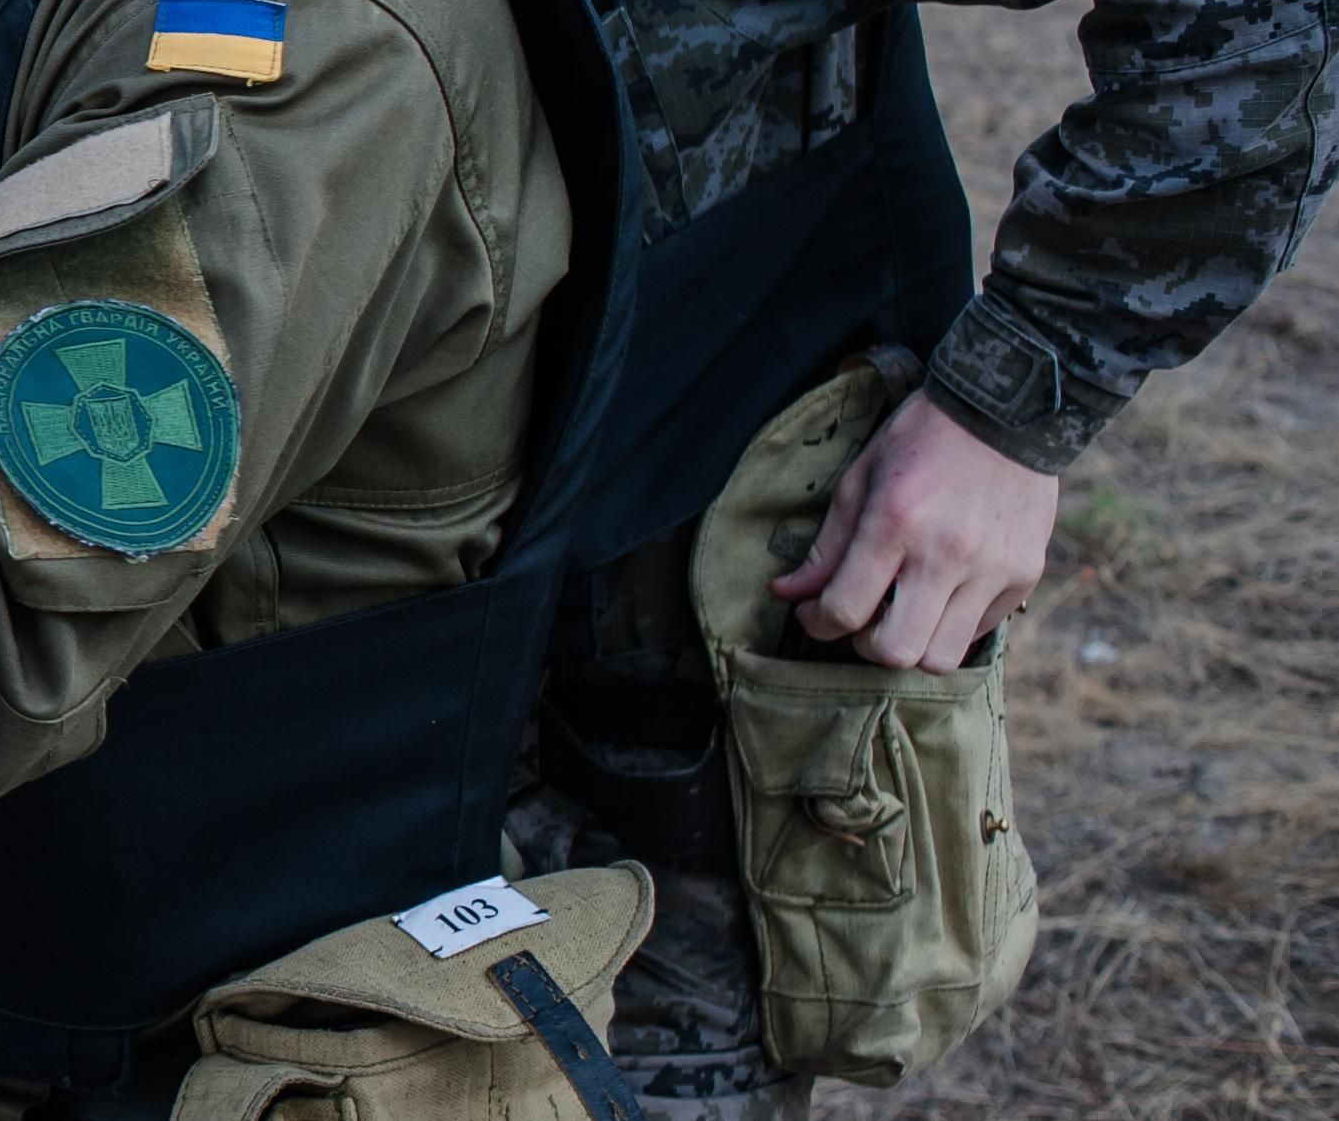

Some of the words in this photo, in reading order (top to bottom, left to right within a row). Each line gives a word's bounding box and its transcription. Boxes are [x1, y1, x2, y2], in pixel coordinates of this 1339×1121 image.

[69, 311, 160, 335] ГВАРДІЯ
[166, 331, 228, 410] УКРАЇНИ
[434, 897, 500, 935] 103
